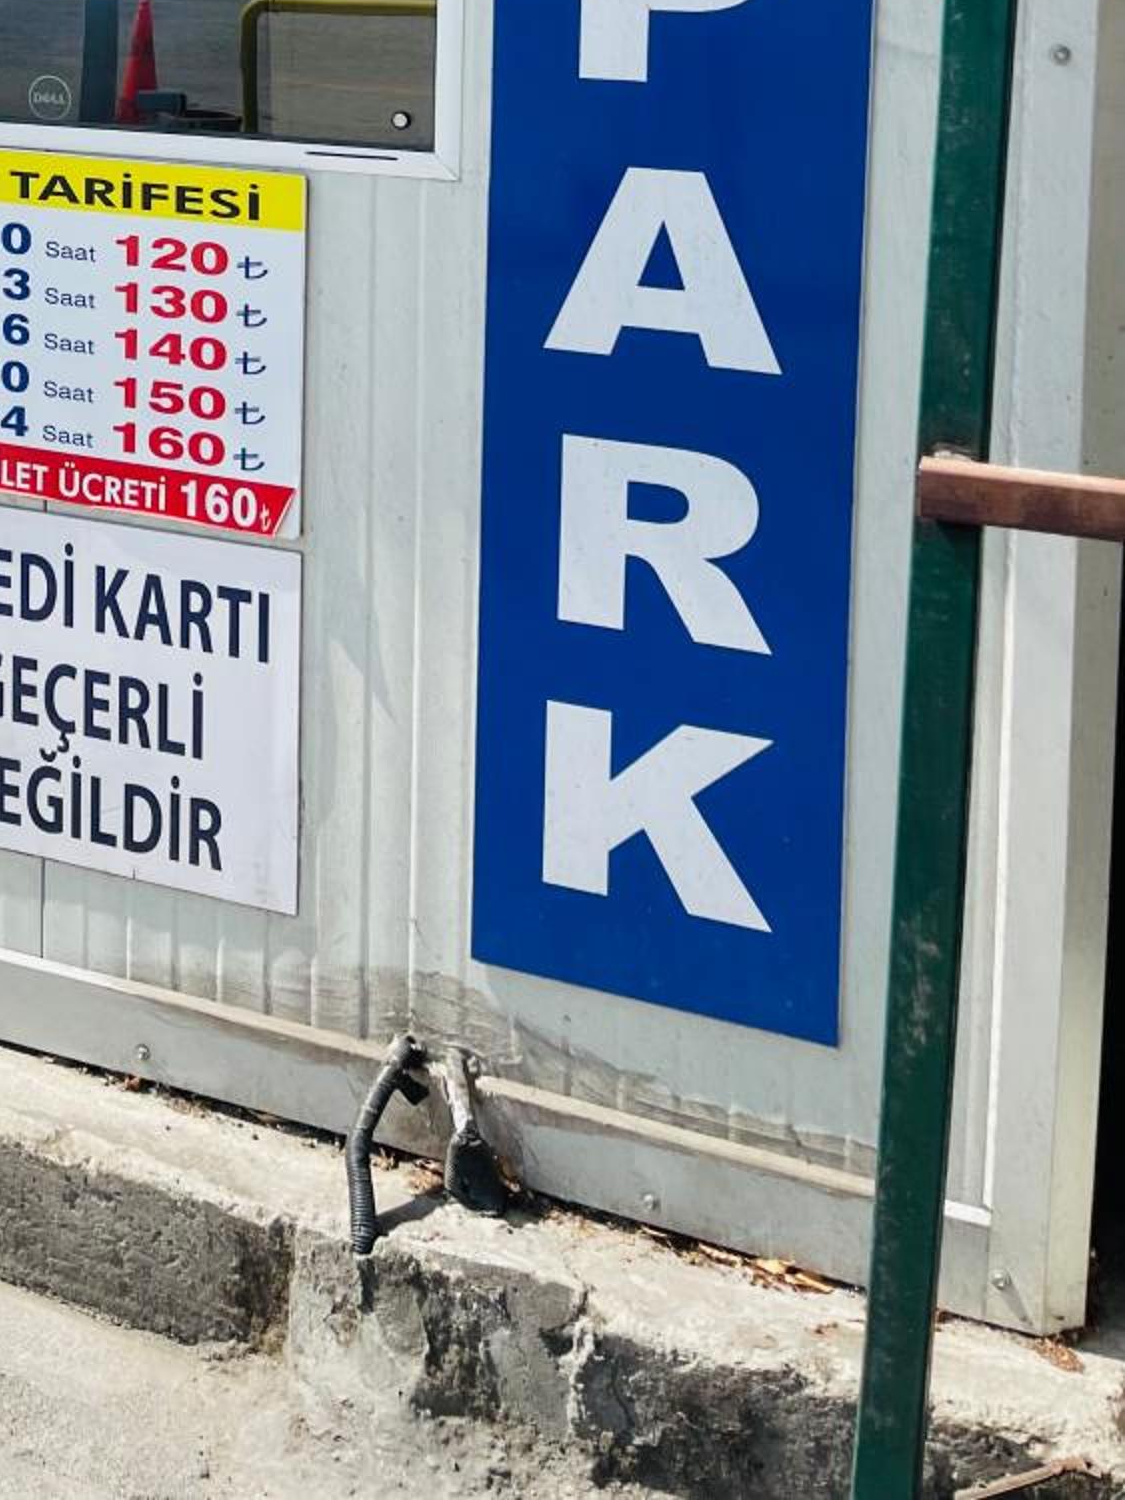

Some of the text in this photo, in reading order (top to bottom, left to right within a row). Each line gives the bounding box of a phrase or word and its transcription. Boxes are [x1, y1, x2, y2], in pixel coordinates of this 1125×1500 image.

[11, 171, 261, 221] TARİFESİ
[45, 241, 96, 263] Saat
[44, 288, 95, 309] Saat
[44, 333, 95, 356] Saat
[43, 381, 94, 404] Saat
[42, 425, 93, 449] Saat
[58, 461, 167, 511] ÜCRETİ
[95, 565, 270, 663] KARTI
